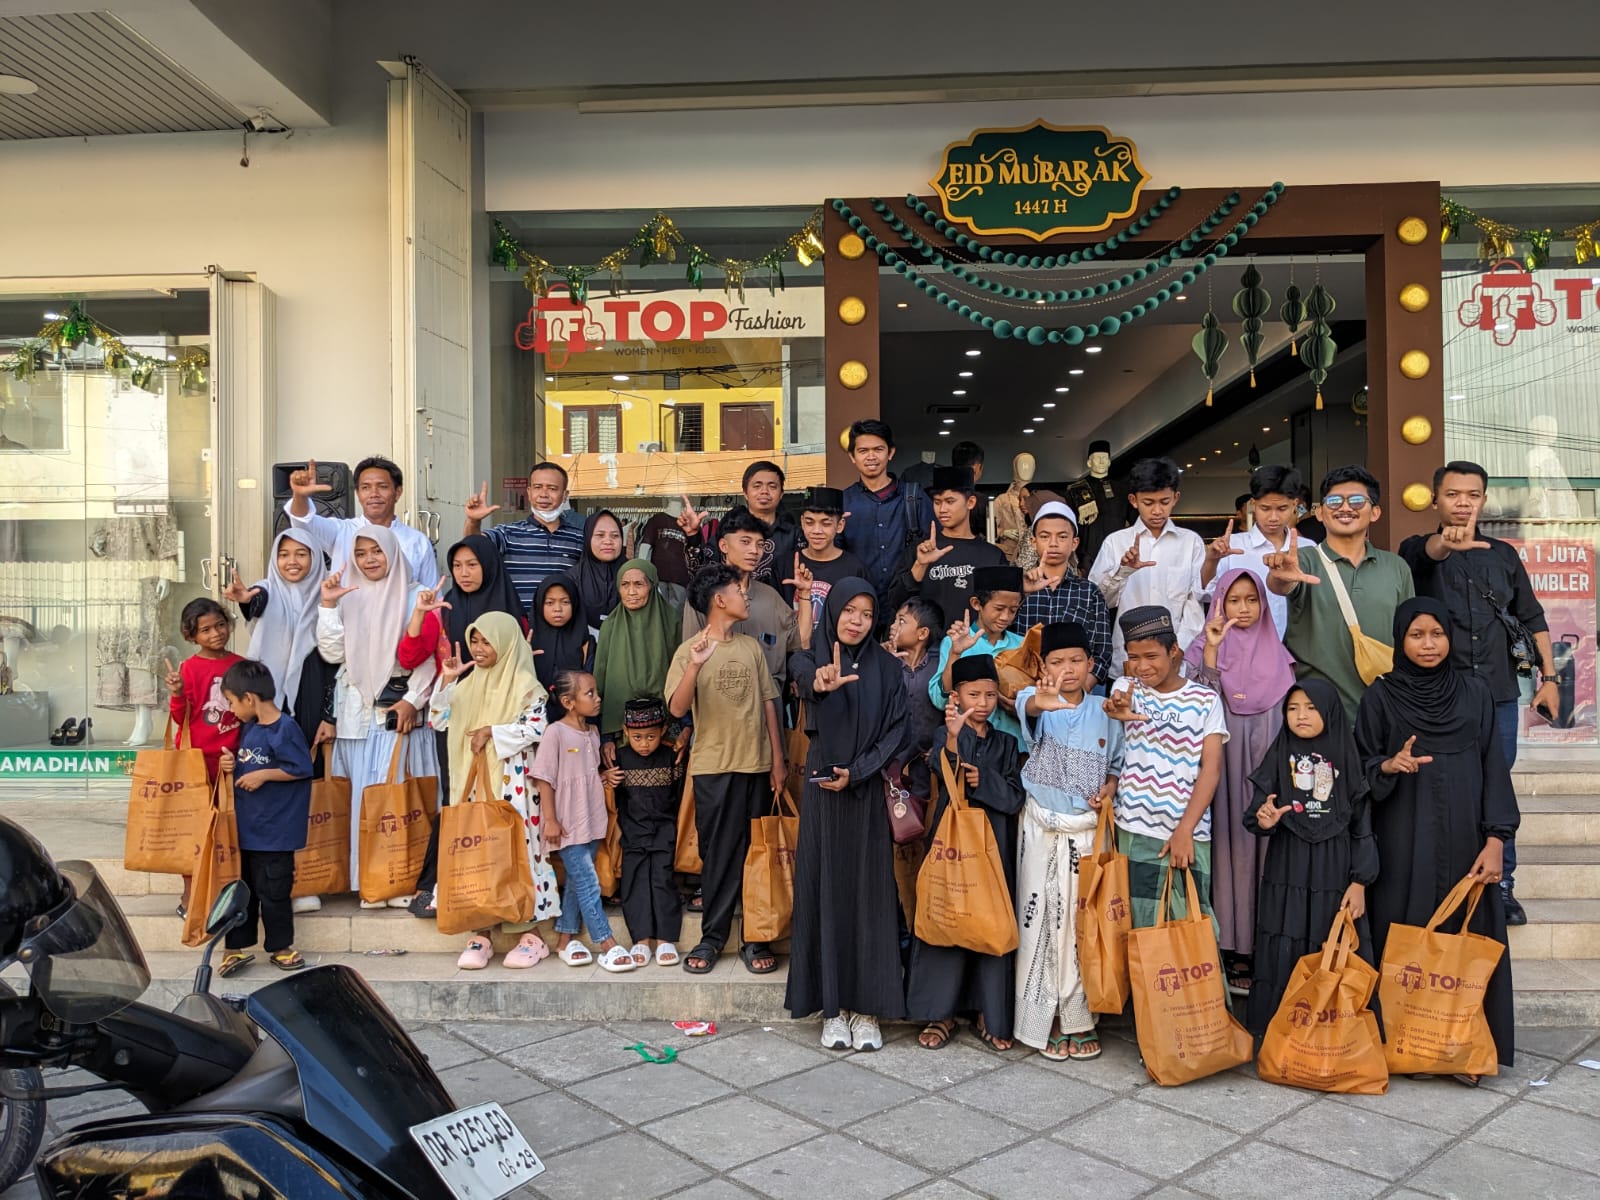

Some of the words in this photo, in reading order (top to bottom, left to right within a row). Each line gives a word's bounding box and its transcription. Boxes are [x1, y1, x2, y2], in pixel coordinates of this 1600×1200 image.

[946, 163, 993, 195] EID
[998, 146, 1131, 192] MUBARAK
[1014, 200, 1049, 215] 1447
[1053, 199, 1067, 214] H
[1554, 278, 1600, 319] T
[604, 300, 728, 342] TOP
[728, 307, 806, 331] Fashion
[1567, 325, 1600, 333] WOME
[615, 347, 653, 356] WOMEN
[0, 756, 110, 773] AMADHAN
[308, 811, 332, 825] TOP
[454, 834, 482, 849] TOP
[1181, 962, 1213, 982] TOP
[422, 1131, 458, 1166] DR
[446, 1116, 494, 1156] 5253
